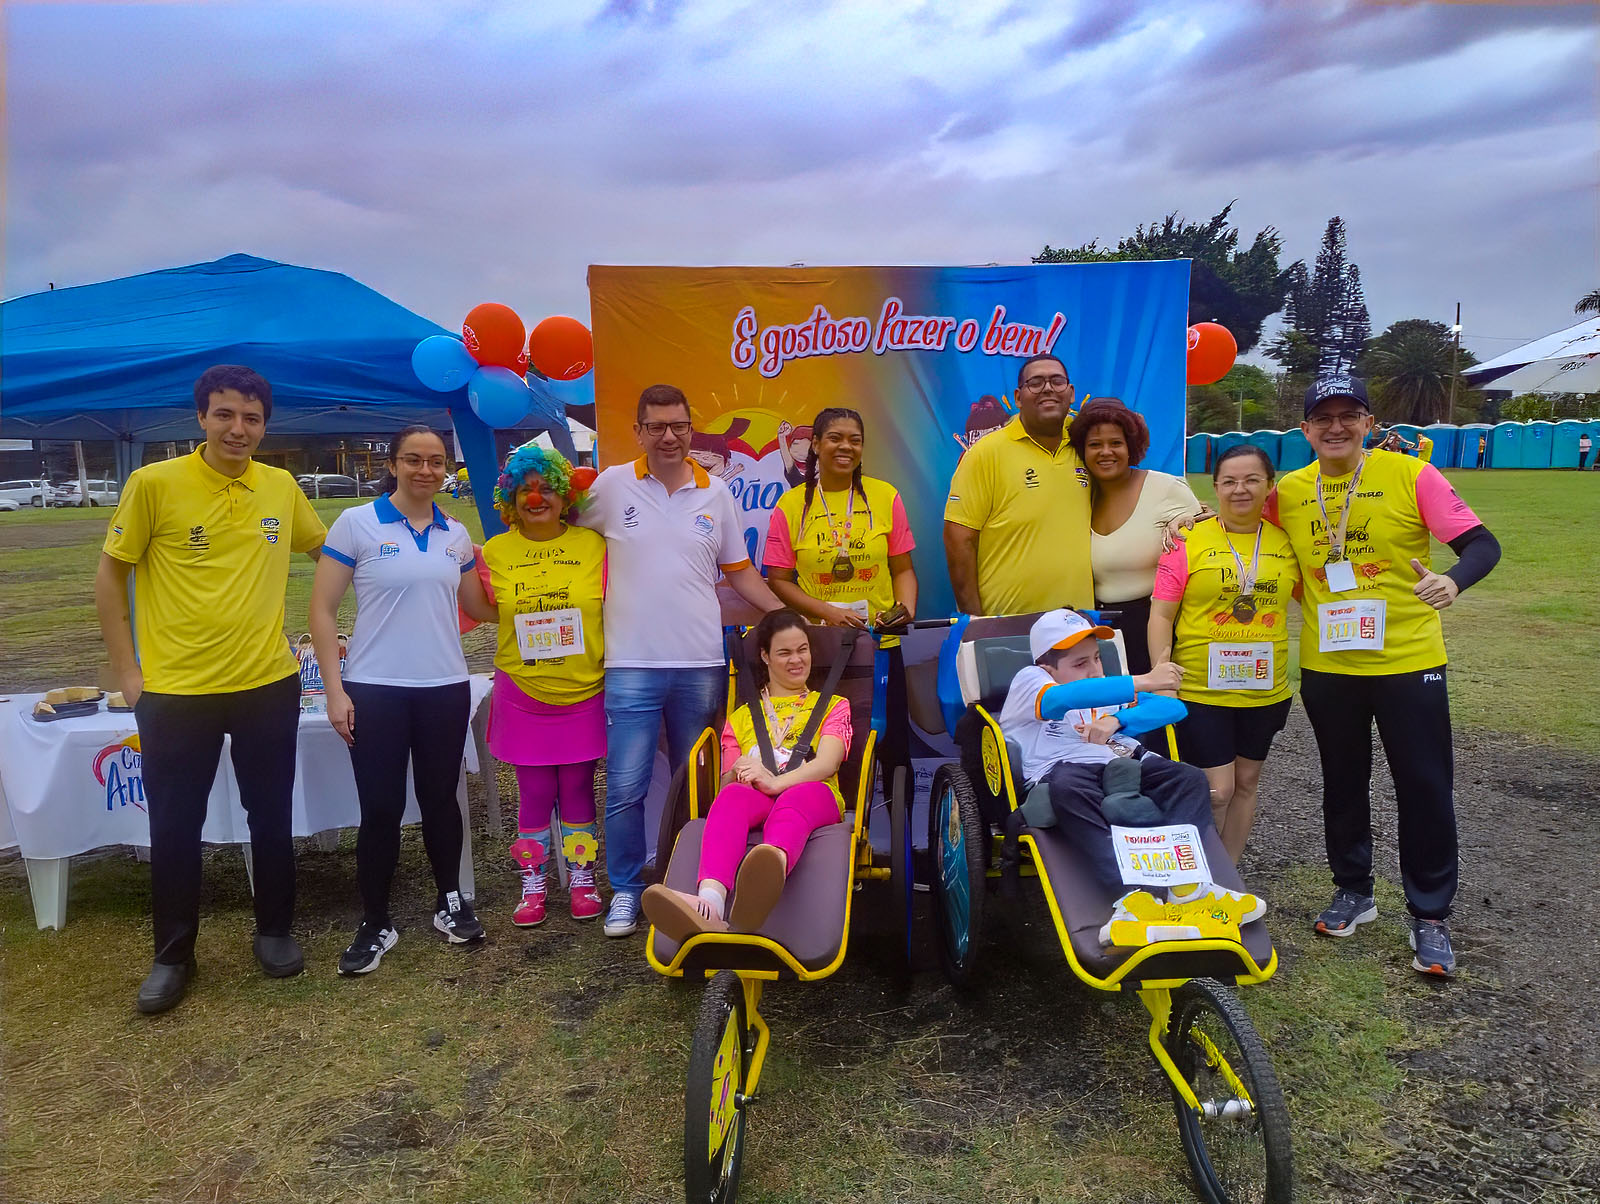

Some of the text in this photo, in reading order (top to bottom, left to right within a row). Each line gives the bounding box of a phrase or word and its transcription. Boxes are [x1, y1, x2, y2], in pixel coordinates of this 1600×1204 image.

[762, 306, 869, 374] gostoso
[874, 299, 956, 352] fazer
[956, 320, 978, 350] o
[985, 306, 1064, 355] bem!
